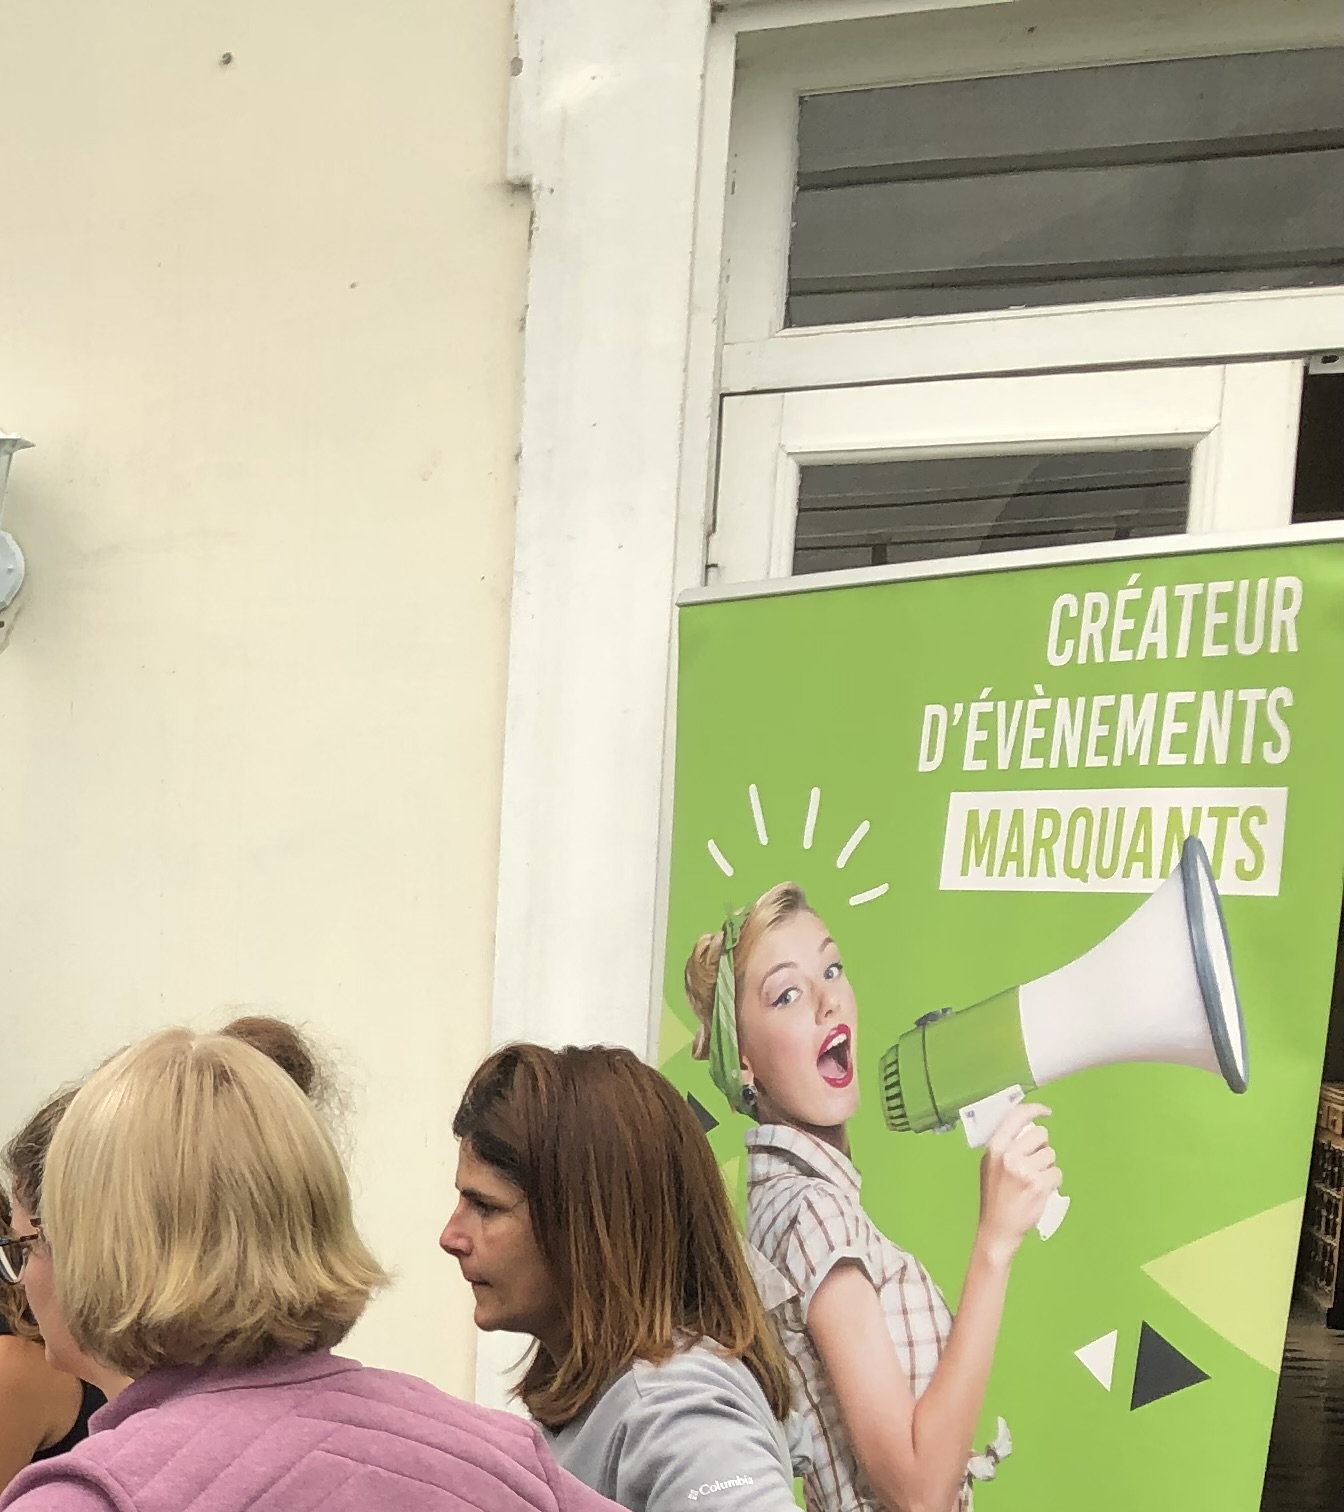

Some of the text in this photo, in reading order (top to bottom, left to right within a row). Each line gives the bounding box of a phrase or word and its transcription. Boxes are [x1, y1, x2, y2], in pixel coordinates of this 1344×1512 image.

[1046, 573, 1303, 667] CRÉATEUR
[918, 684, 1294, 772] D'ÉVÈNEMENTS
[960, 804, 1268, 882] MARQUANTS
[698, 1474, 754, 1496] Columbia
